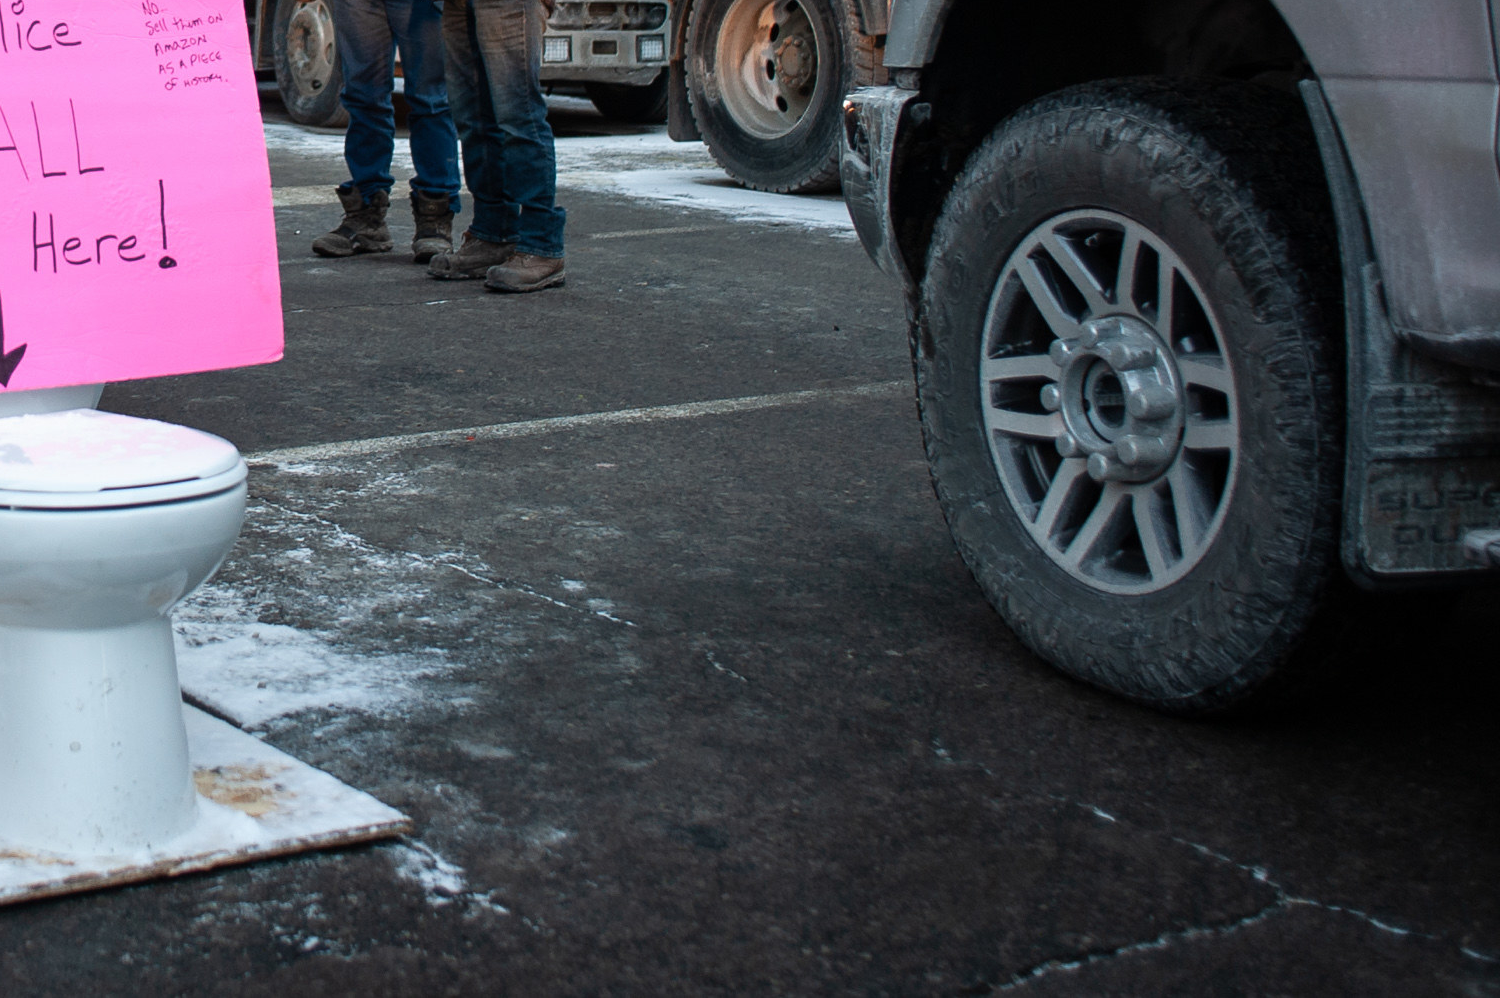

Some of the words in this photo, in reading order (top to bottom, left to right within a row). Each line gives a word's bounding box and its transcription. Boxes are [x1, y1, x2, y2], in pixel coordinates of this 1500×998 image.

[159, 62, 174, 74] AS
[179, 60, 187, 69] A
[190, 51, 222, 66] PIECE
[32, 179, 177, 273] Here!
